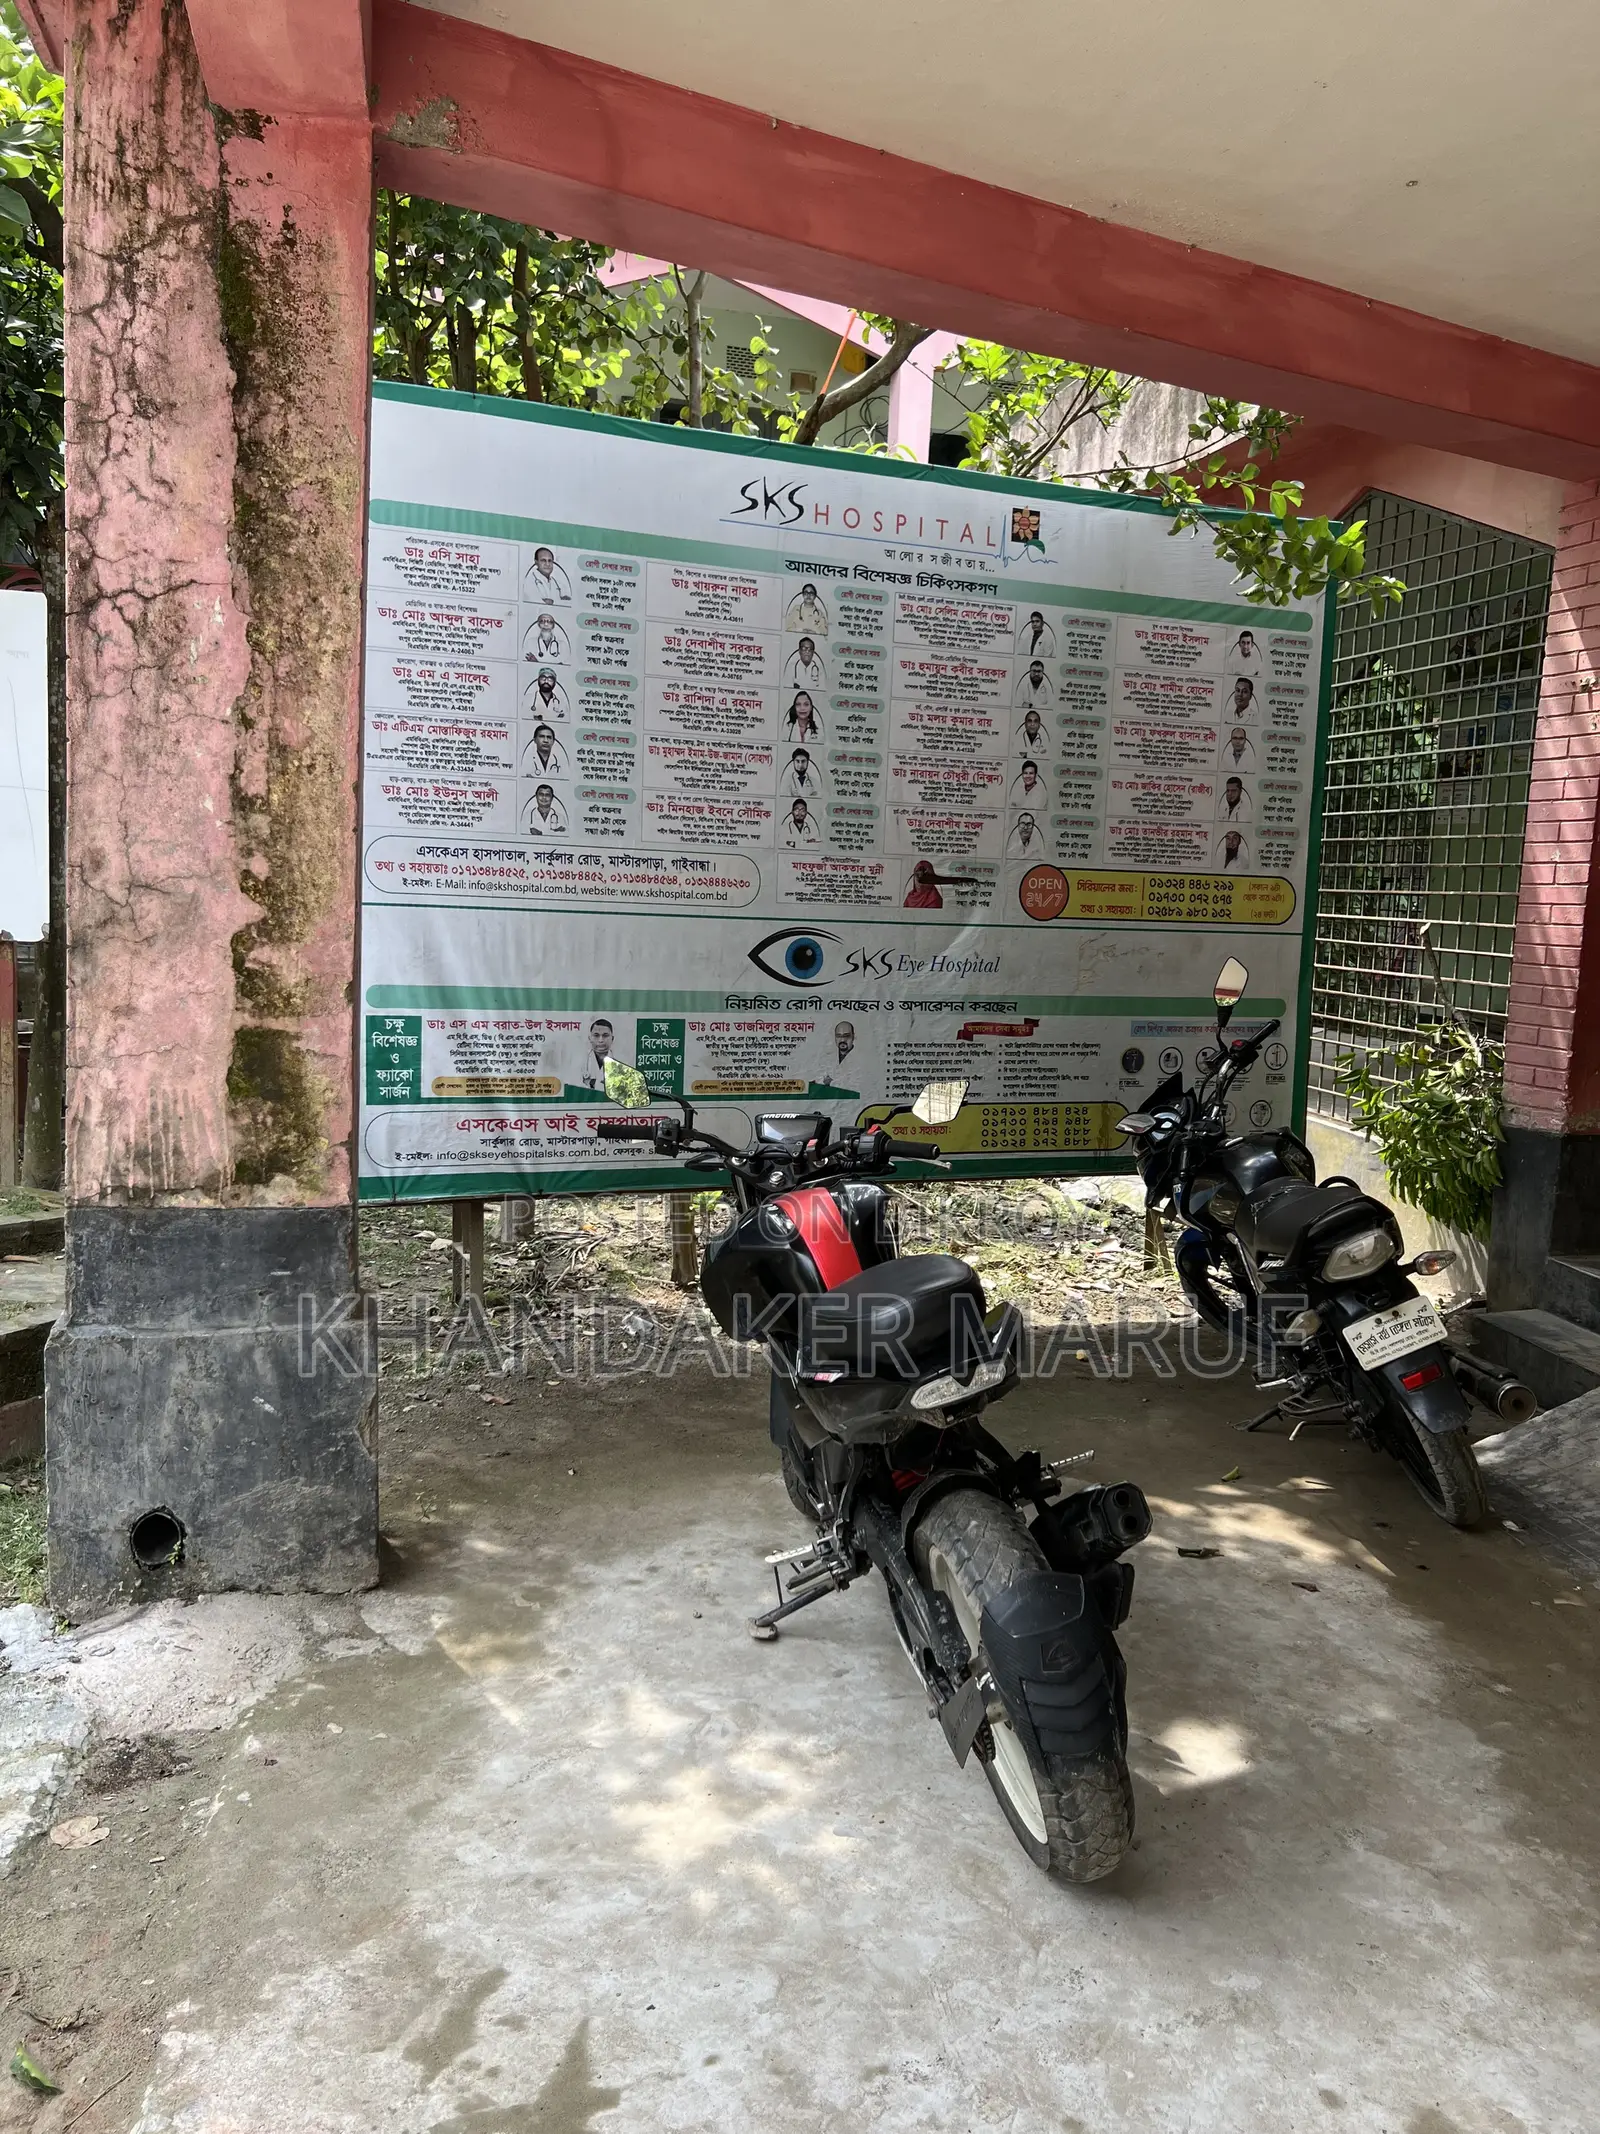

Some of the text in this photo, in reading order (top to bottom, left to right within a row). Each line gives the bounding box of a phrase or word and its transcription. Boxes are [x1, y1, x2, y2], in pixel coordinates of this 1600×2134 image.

[730, 476, 997, 548] SKS HOSPITAL
[403, 546, 480, 566] ডাঃ এসি সাহা
[785, 559, 997, 596] আমাদের বিশেষজ্ঞ চিকিৎসকগণ
[671, 578, 688, 589] ডাঃ
[730, 585, 758, 596] নাহার
[377, 607, 503, 628] ডাঃ মোঃ আব্দুল বাসেত
[584, 617, 598, 626] রোগী
[664, 635, 681, 646] ডাঃ
[728, 643, 763, 654] সরকার
[1134, 630, 1148, 639] ডাঃ
[1181, 632, 1209, 645] ইসলাম
[391, 666, 490, 685] ডাঃ এম এ সালেহ
[907, 712, 992, 727] ডাঃ মলয় কুমার রায়
[371, 720, 508, 741] ডাঃ এটিএম মোস্তাফিজুর রহমান
[380, 784, 499, 803] ডাঃ মোঃ ইউনুস আলী
[416, 845, 469, 859] এসকেএস
[471, 848, 529, 865] হাসপাতাল,
[533, 848, 574, 867] সার্কুলার
[577, 853, 604, 868] রোড,
[607, 853, 666, 872] মাস্টারপাড়া,
[374, 861, 394, 872] তথ্য
[397, 862, 405, 871] ও
[451, 864, 528, 880] ০১৭১৩৪৮৪৫২৫,
[532, 868, 606, 883] ০১৭১৩৪৮৪৪৫২,
[684, 876, 750, 888] ০১৩২৪৪৪৬২৩০
[829, 863, 865, 875] আকতার
[436, 878, 466, 889] E-Mail:
[468, 879, 578, 895] info@skshospital.com.bd,
[580, 885, 618, 895] website:
[619, 888, 727, 900] www.skshospital.com.bd
[1028, 877, 1061, 889] OPEN
[1149, 877, 1233, 891] ০১৩২৪ ৪৪৬ ২৯১
[1024, 891, 1063, 908] 24/7
[1148, 891, 1232, 904] ০১৭৩০ ০৭২ ৫৭৫
[1079, 904, 1095, 913] তথ্য
[1096, 904, 1102, 913] ও
[1147, 905, 1231, 919] ০২৫৮৯ ৯৮০ ১৩২
[838, 946, 1000, 980] SKS Eye Hospital
[724, 994, 1017, 1013] নিয়মিত রোগী দেখছেন ও অপারেশন করছেন
[384, 1017, 405, 1033] চক্ষু
[426, 1018, 581, 1031] ডাঃ এস এম বরাত-উল ইসলাম
[652, 1022, 670, 1036] চক্ষু
[688, 1018, 814, 1034] ডাঃ মোঃ তাজমিলুর রহমান
[371, 1032, 419, 1047] বিশেষজ্ঞ
[640, 1035, 680, 1049] বিশেষজ্ঞ
[389, 1053, 399, 1063] ও
[674, 1055, 683, 1064] ও
[375, 1068, 413, 1081] ফ্যাকো
[378, 1081, 411, 1098] সার্জন
[982, 1106, 1089, 1117] ০১৭১৩ ৪৮৪ ৪২৪
[456, 1116, 539, 1134] এসকেএস
[547, 1116, 580, 1133] আই
[981, 1116, 1092, 1128] ০১৭৩০ ৭৯৪ ৯৪৮
[892, 1125, 907, 1136] তথ্য
[910, 1126, 917, 1135] ও
[981, 1126, 1092, 1138] ০১৭৩০ ০৭২ ৫৮৮
[480, 1134, 515, 1150] সার্কুলার
[518, 1137, 542, 1149] রোড,
[980, 1137, 1092, 1148] ০১৩২৪ ১৭২ ৪৮৮
[436, 1147, 610, 1161] info@skseyehospitalsks.com.bd,
